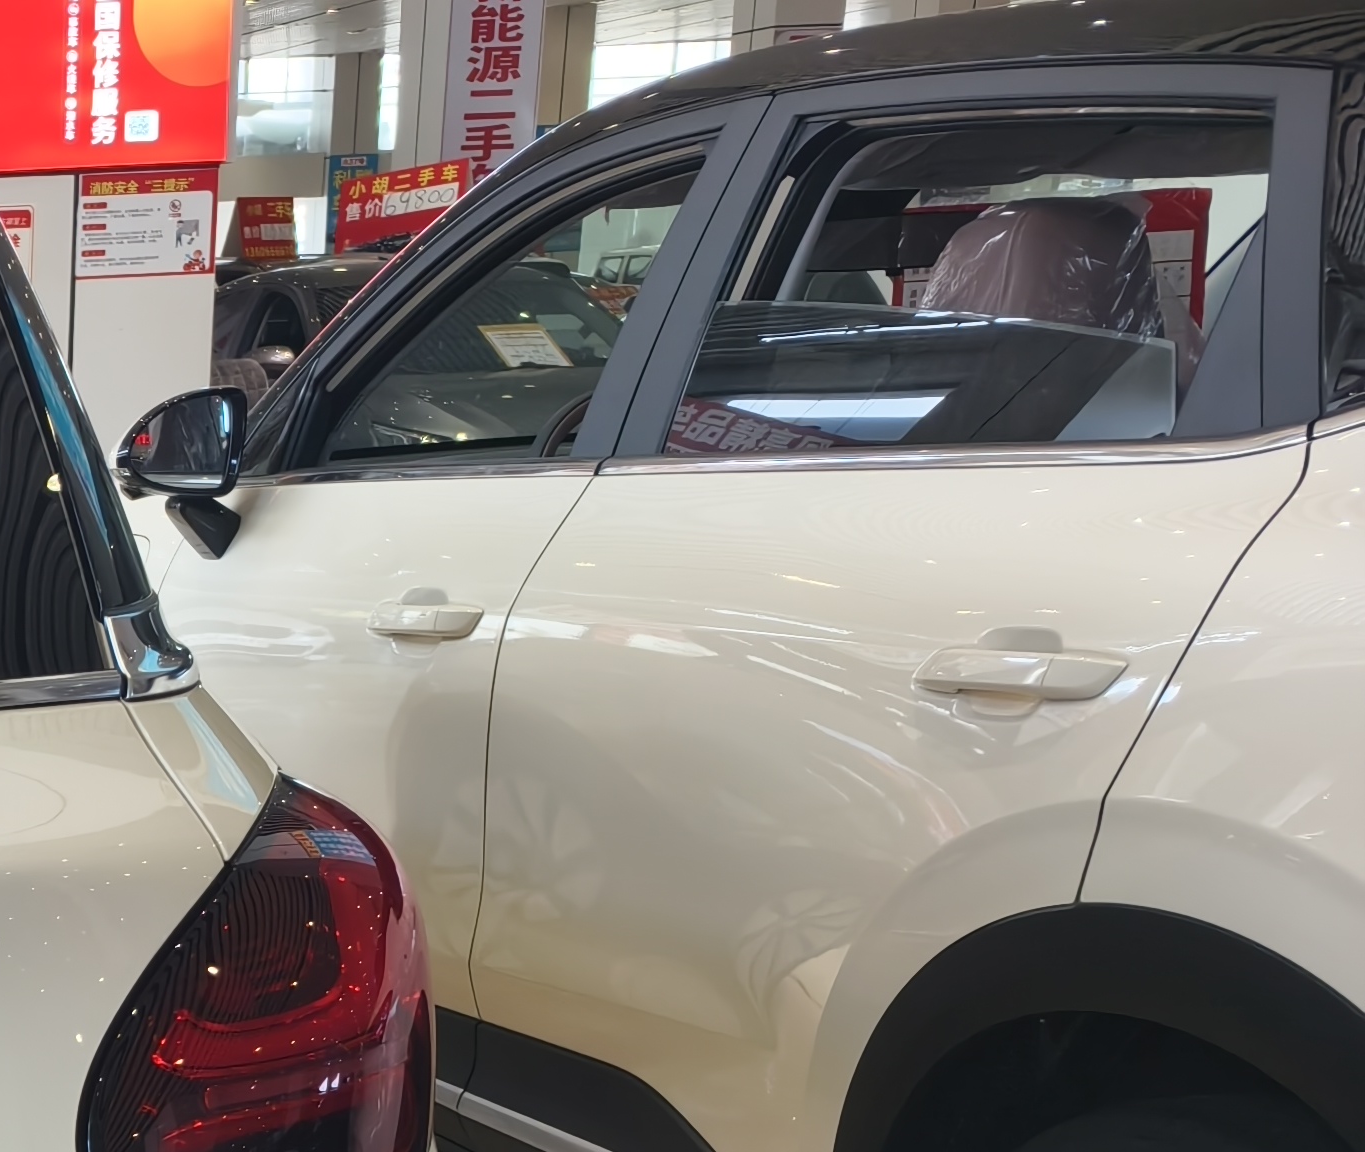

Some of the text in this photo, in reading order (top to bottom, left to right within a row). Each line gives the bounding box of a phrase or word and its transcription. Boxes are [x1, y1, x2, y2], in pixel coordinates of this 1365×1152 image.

[91, 0, 121, 145] 国保修服务
[460, 0, 525, 187] 能源二手
[345, 199, 383, 223] 售价
[348, 163, 461, 200] 小胡二手车
